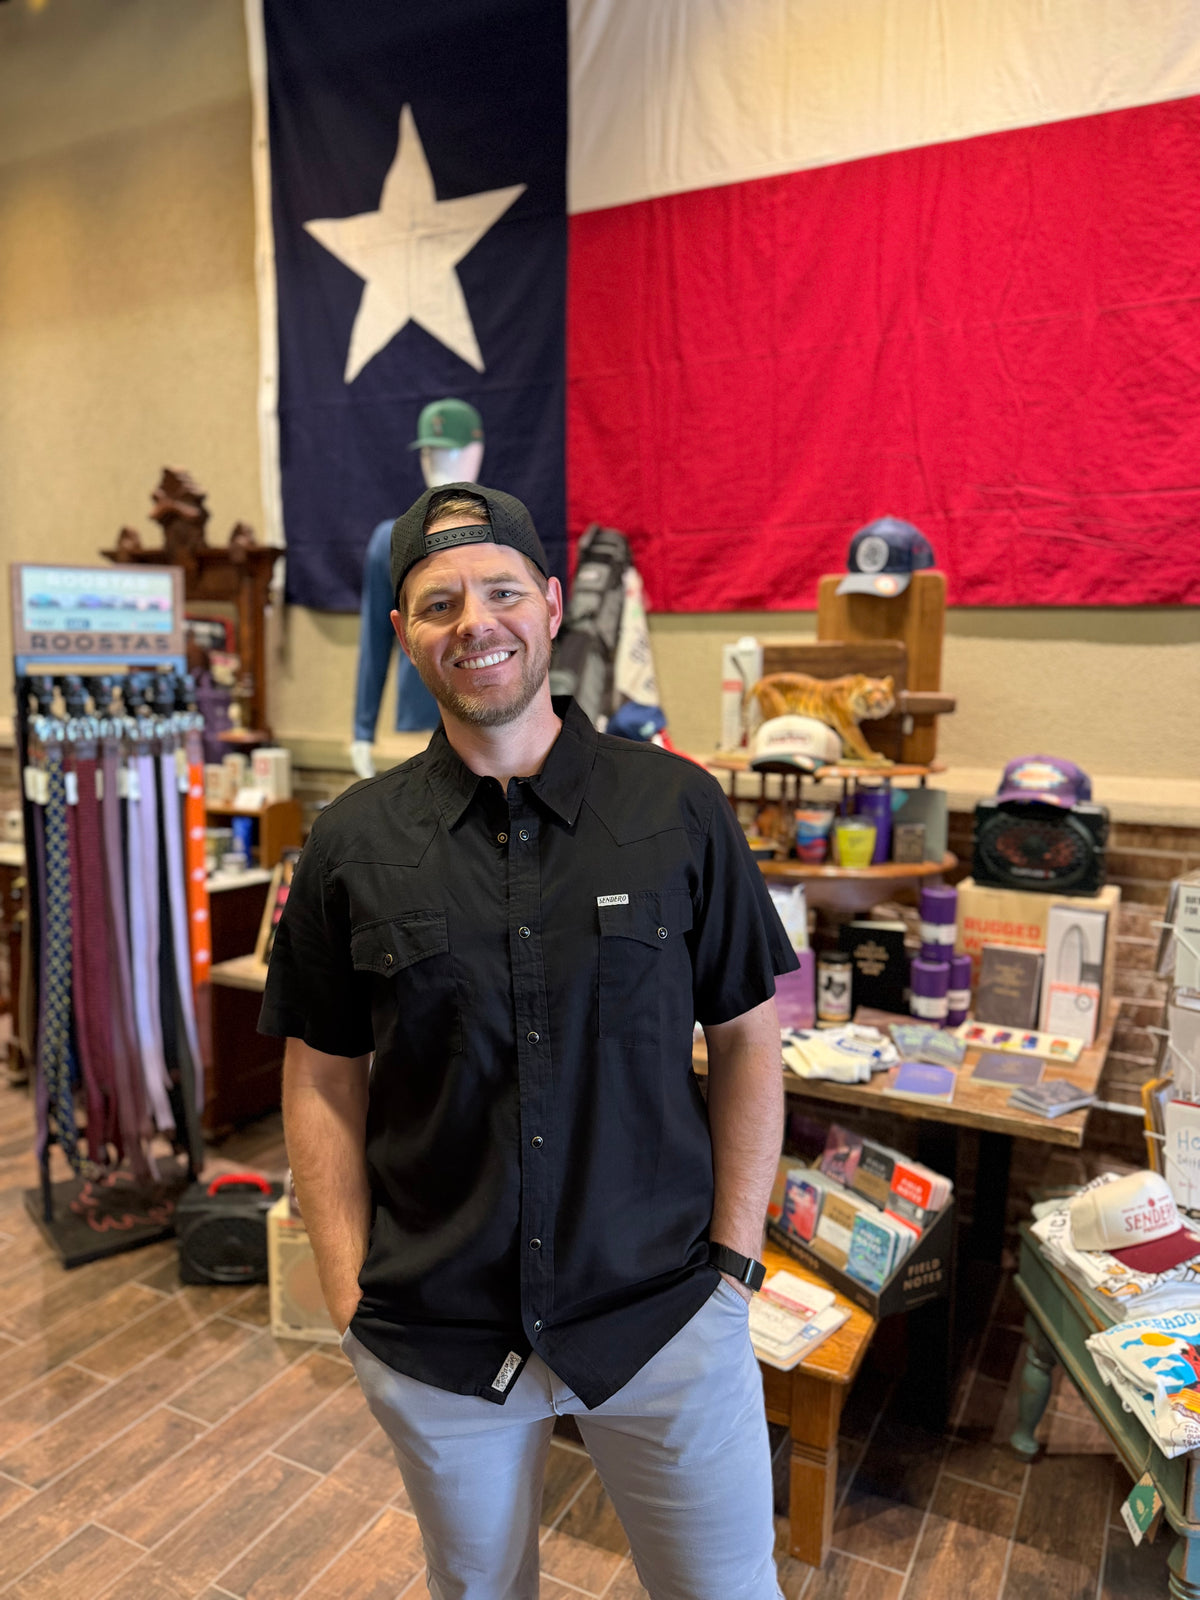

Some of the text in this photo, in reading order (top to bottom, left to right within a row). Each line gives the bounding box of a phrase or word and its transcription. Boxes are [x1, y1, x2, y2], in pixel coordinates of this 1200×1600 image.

[31, 634, 169, 650] ROOSTAS
[599, 895, 627, 904] SENDERO
[907, 1257, 941, 1278] FIELD
[903, 1270, 943, 1291] NOTES
